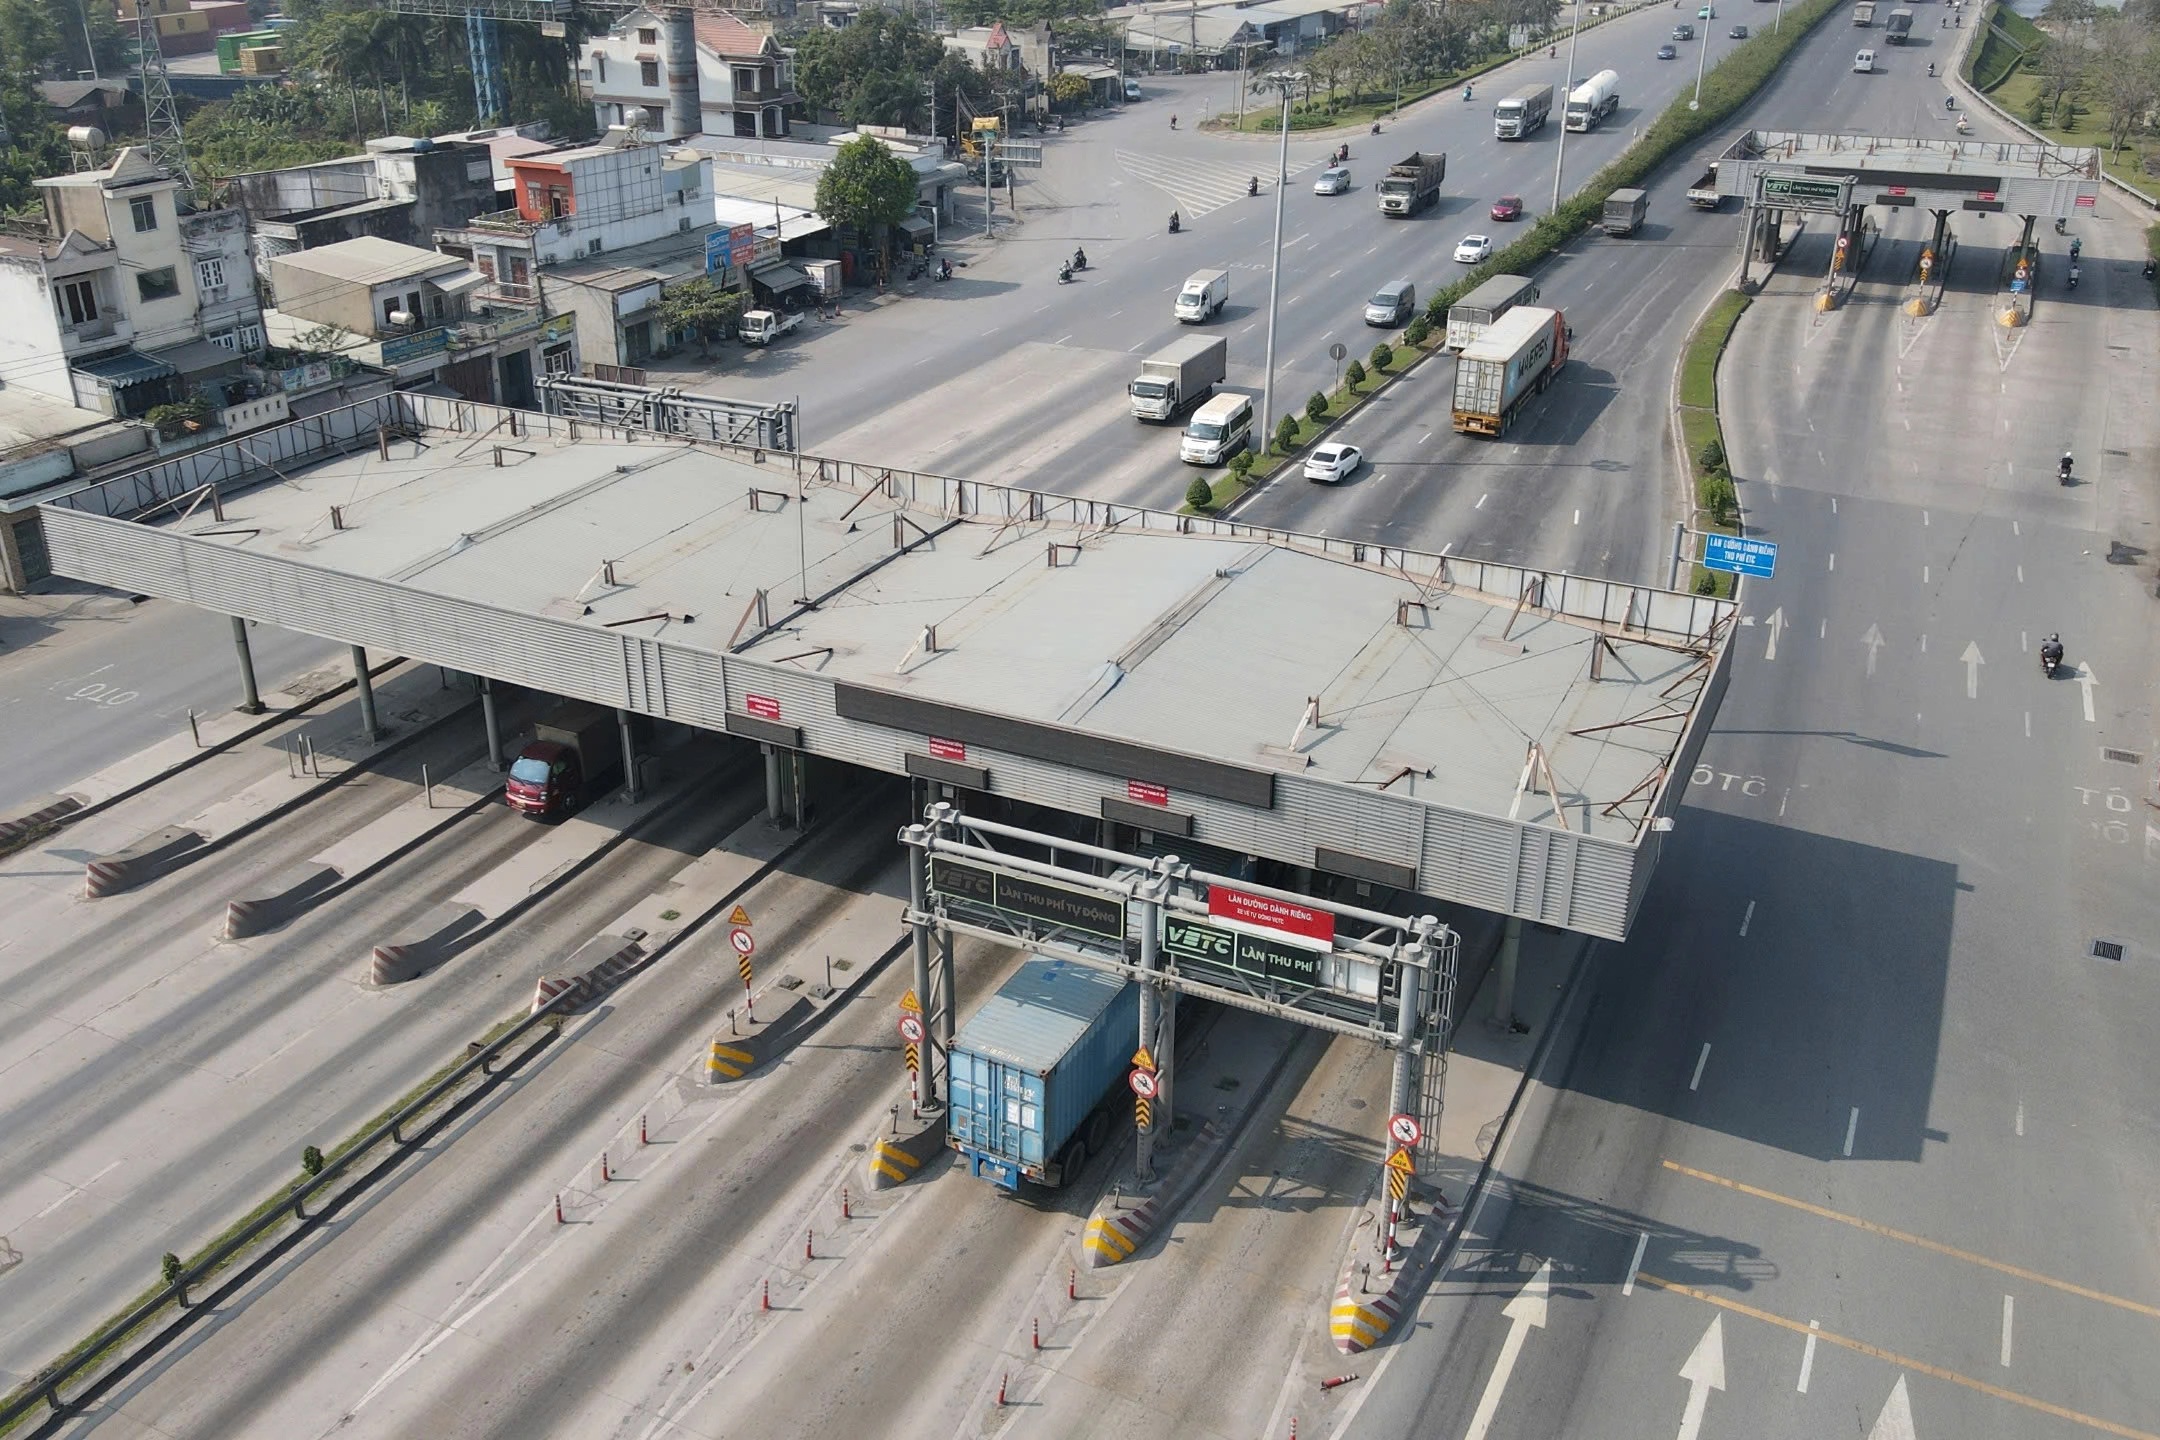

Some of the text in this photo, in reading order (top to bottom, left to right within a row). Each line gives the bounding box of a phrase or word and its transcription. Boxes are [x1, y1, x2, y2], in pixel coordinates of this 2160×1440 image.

[1518, 334, 1550, 379] MAERSK
[934, 867, 990, 894] VETC
[1000, 884, 1116, 923] LÀN THU PHÍ TỰ ĐỘNG
[1228, 894, 1242, 904] LÀN
[1168, 926, 1231, 954] VETC
[1241, 945, 1313, 973] LÀN THU PHÍ
